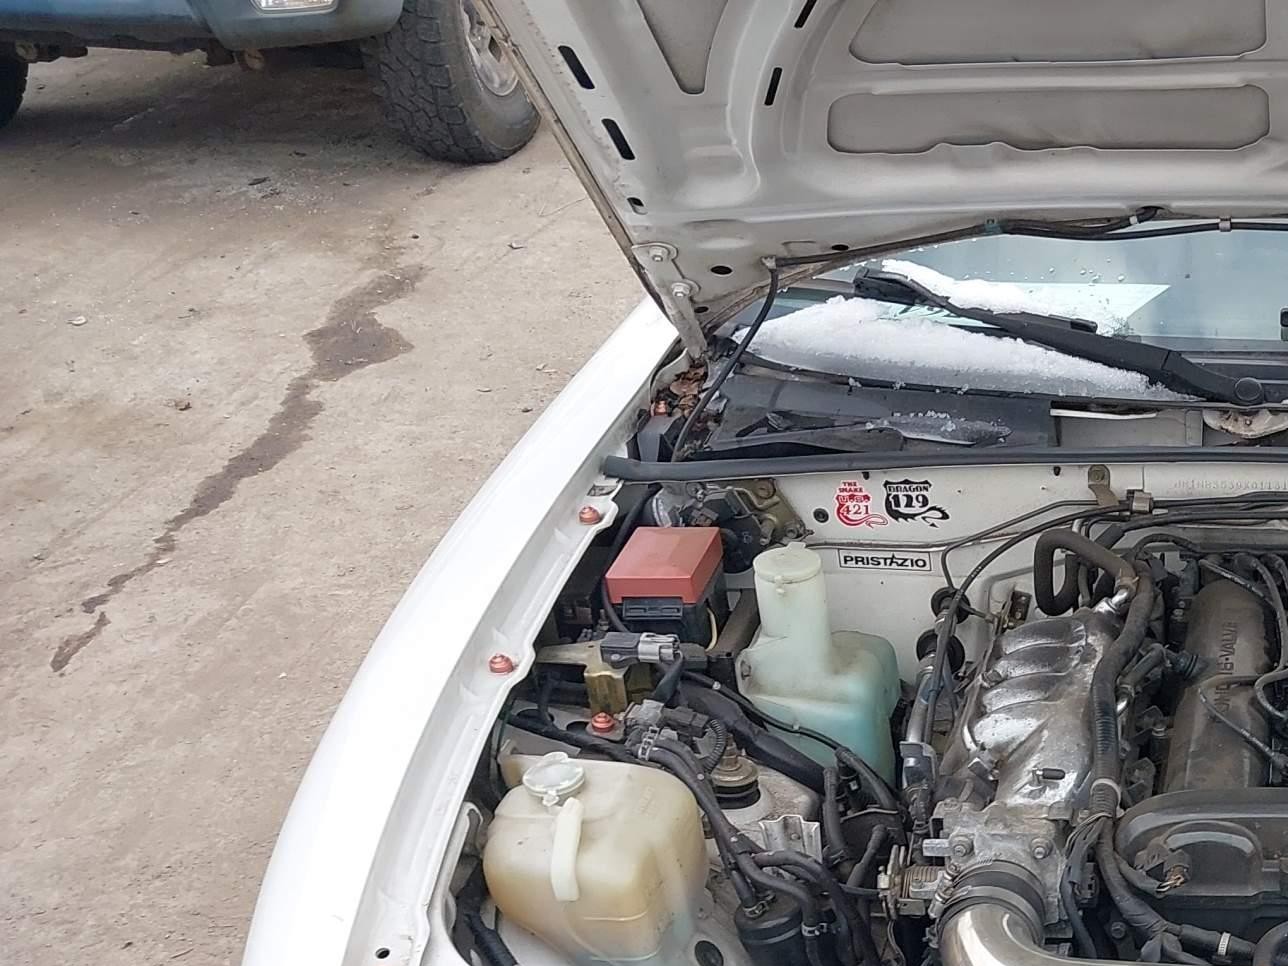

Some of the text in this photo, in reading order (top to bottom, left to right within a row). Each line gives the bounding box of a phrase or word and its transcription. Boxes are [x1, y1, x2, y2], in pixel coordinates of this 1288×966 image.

[887, 485, 929, 493] DRAGON
[840, 495, 869, 503] U.S.
[891, 493, 929, 508] 129
[840, 503, 869, 515] 421
[843, 553, 927, 568] PRISTAZIO
